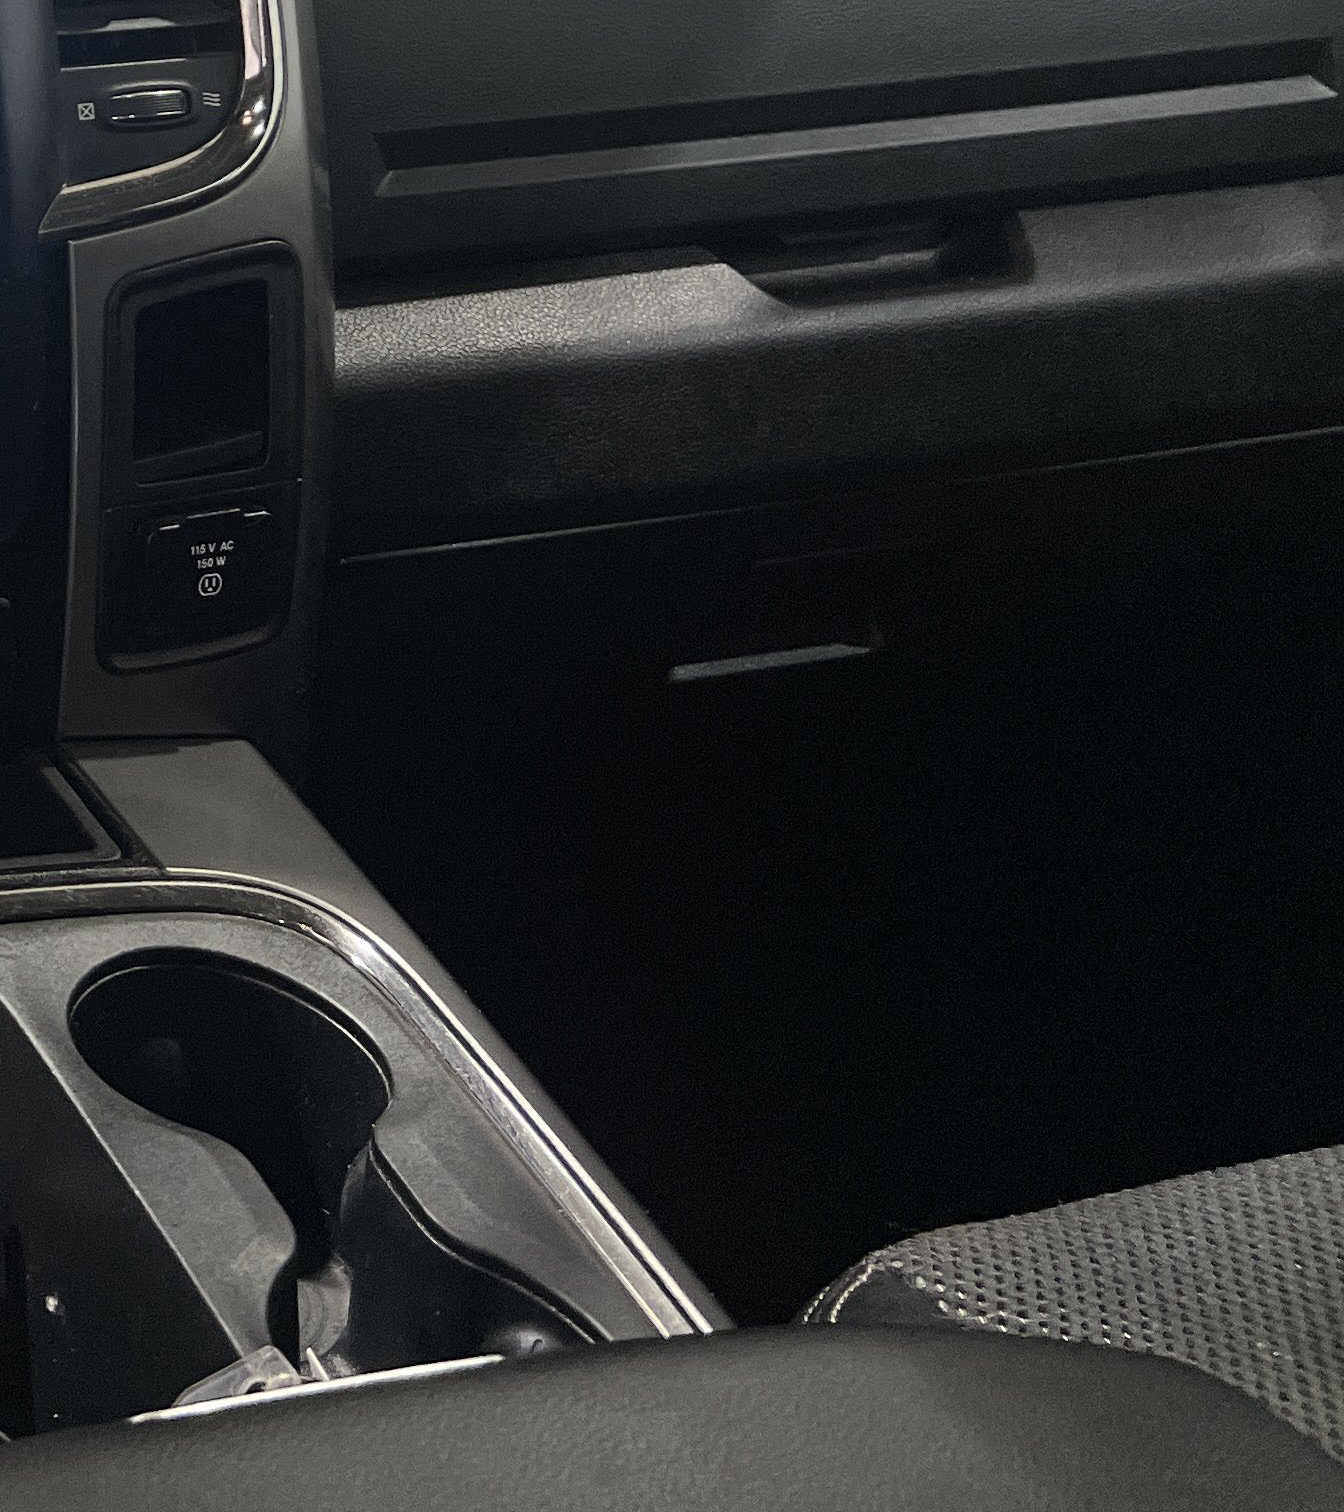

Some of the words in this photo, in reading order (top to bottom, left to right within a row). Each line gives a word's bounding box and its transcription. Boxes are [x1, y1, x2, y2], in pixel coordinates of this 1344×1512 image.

[191, 544, 206, 555] 115
[208, 543, 216, 553] V
[220, 540, 234, 551] AC
[197, 558, 213, 569] 150
[216, 556, 227, 566] W
